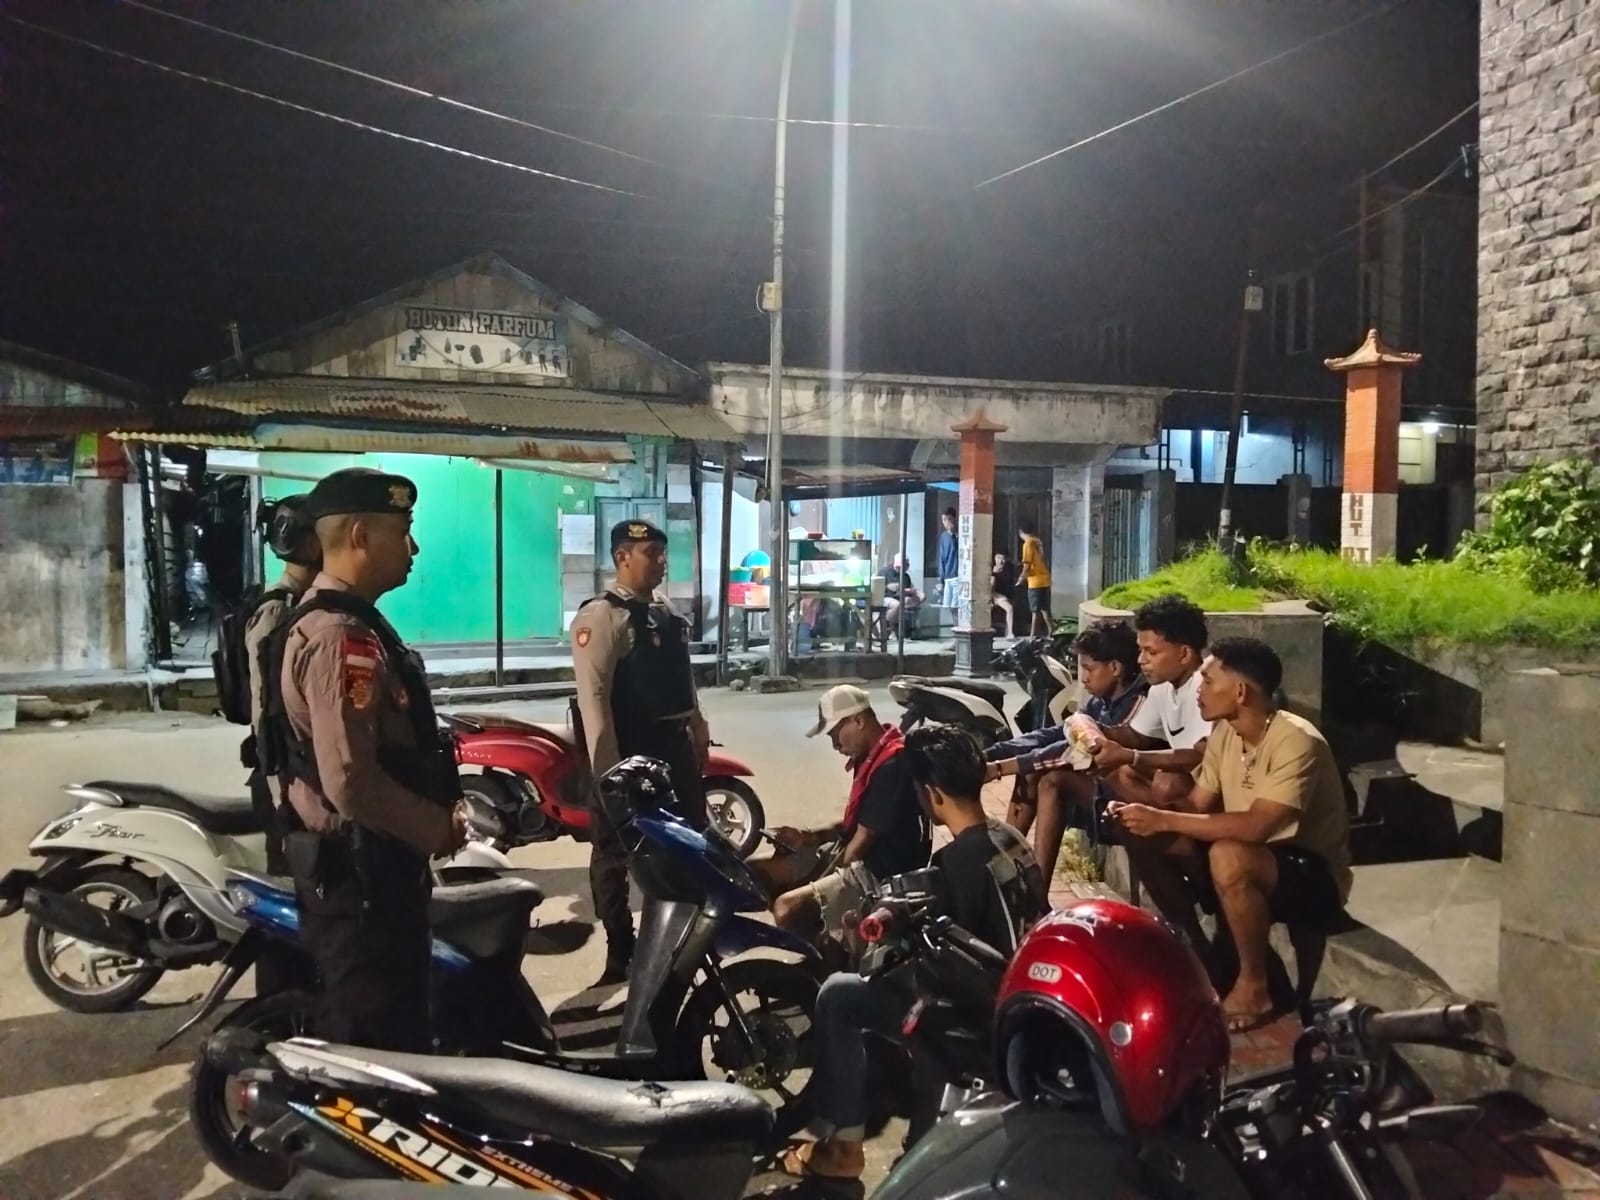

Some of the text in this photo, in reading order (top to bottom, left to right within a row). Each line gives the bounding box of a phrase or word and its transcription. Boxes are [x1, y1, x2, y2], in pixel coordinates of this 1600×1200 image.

[407, 308, 555, 340] BUTON PARFUM
[962, 515, 970, 545] HUT
[1350, 493, 1363, 536] HUT
[1032, 965, 1057, 979] DOT
[479, 1145, 575, 1193] EXTREME
